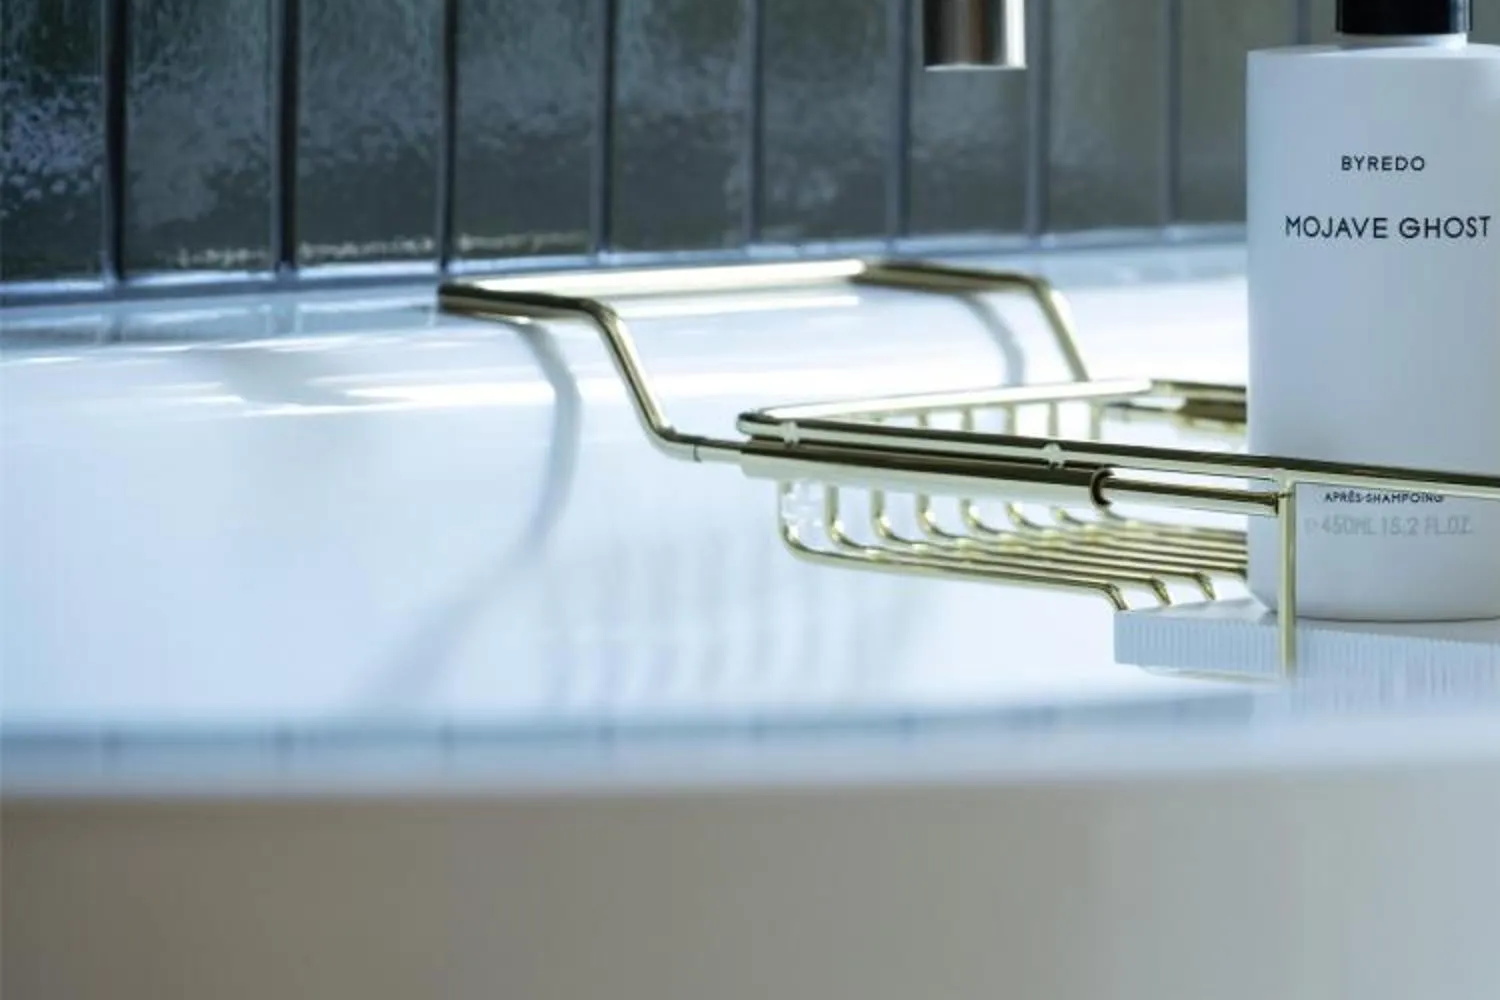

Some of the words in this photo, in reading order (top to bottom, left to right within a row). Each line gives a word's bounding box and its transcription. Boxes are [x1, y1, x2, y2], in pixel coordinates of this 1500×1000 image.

[1340, 154, 1426, 173] BYREDO
[1284, 215, 1389, 240] MOJAVE
[1397, 215, 1492, 240] GHOST
